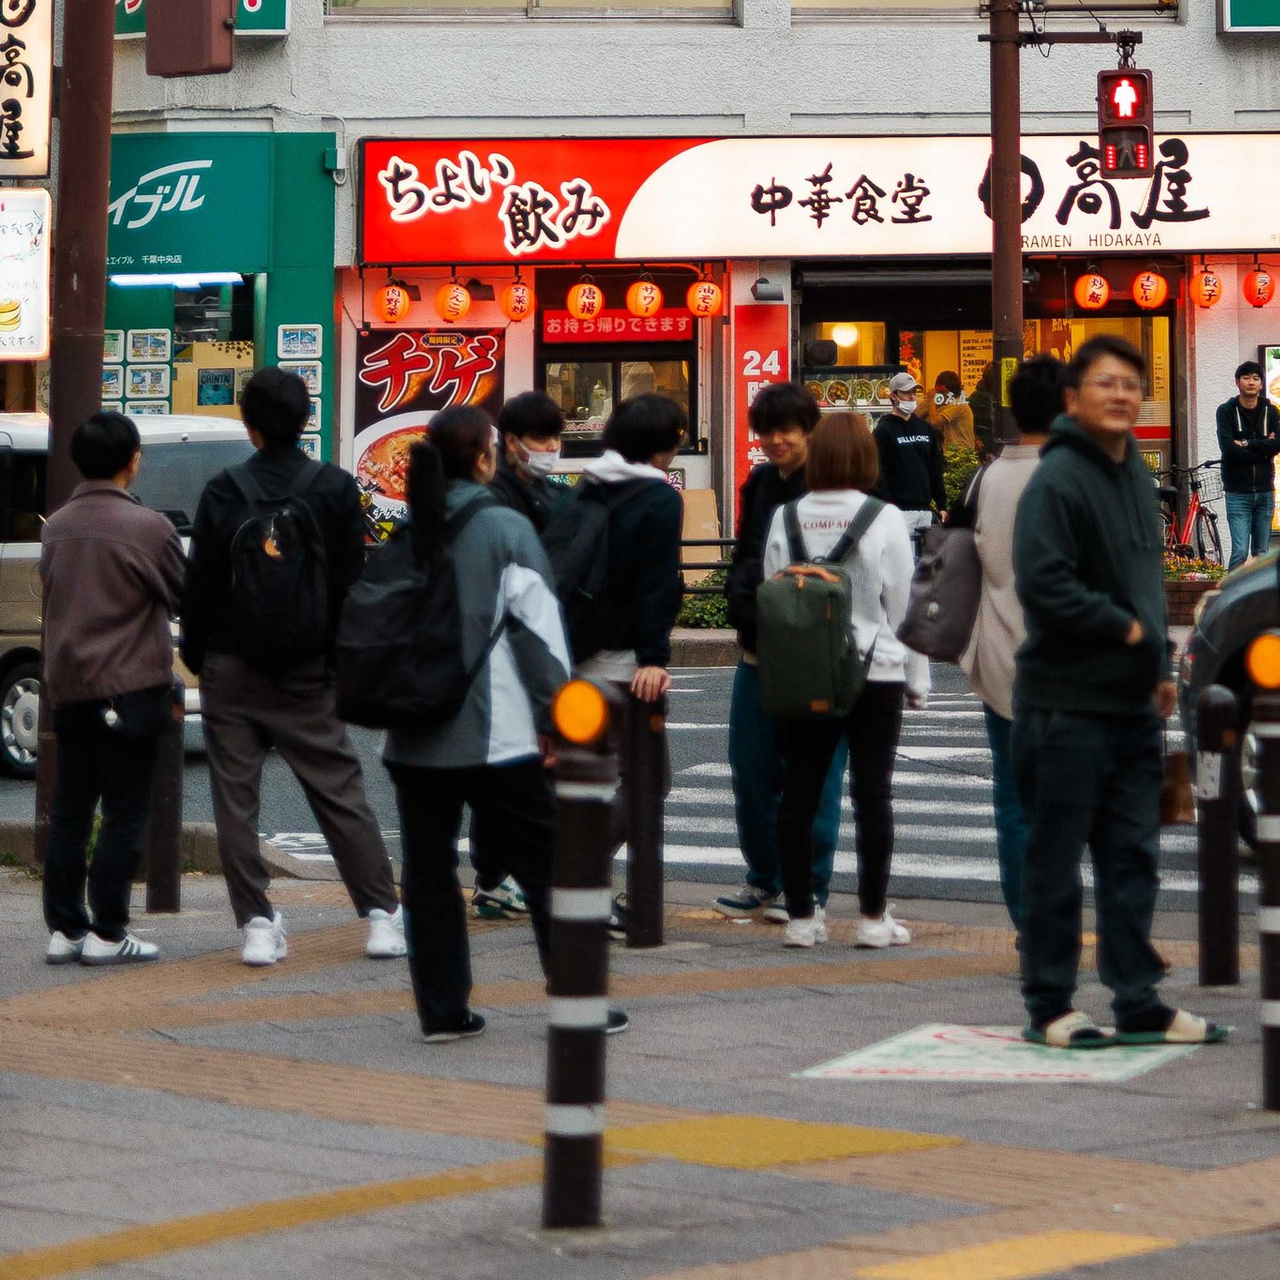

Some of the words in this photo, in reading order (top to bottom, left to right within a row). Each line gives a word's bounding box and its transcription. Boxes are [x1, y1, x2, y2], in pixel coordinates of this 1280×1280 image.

[107, 159, 213, 229] イブル
[380, 150, 514, 222] ちょい
[750, 162, 934, 228] 中華食堂
[500, 178, 611, 255] 飲み
[1020, 234, 1073, 248] RAMEN
[1089, 233, 1162, 248] HIDAKAYA
[579, 287, 596, 315] 唐揚
[641, 284, 657, 314] サワー
[695, 285, 715, 314] 油そば
[1201, 275, 1218, 302] 餃子
[546, 315, 690, 335] お持ち帰りできます
[359, 332, 499, 414] チゲ
[743, 349, 781, 376] 24
